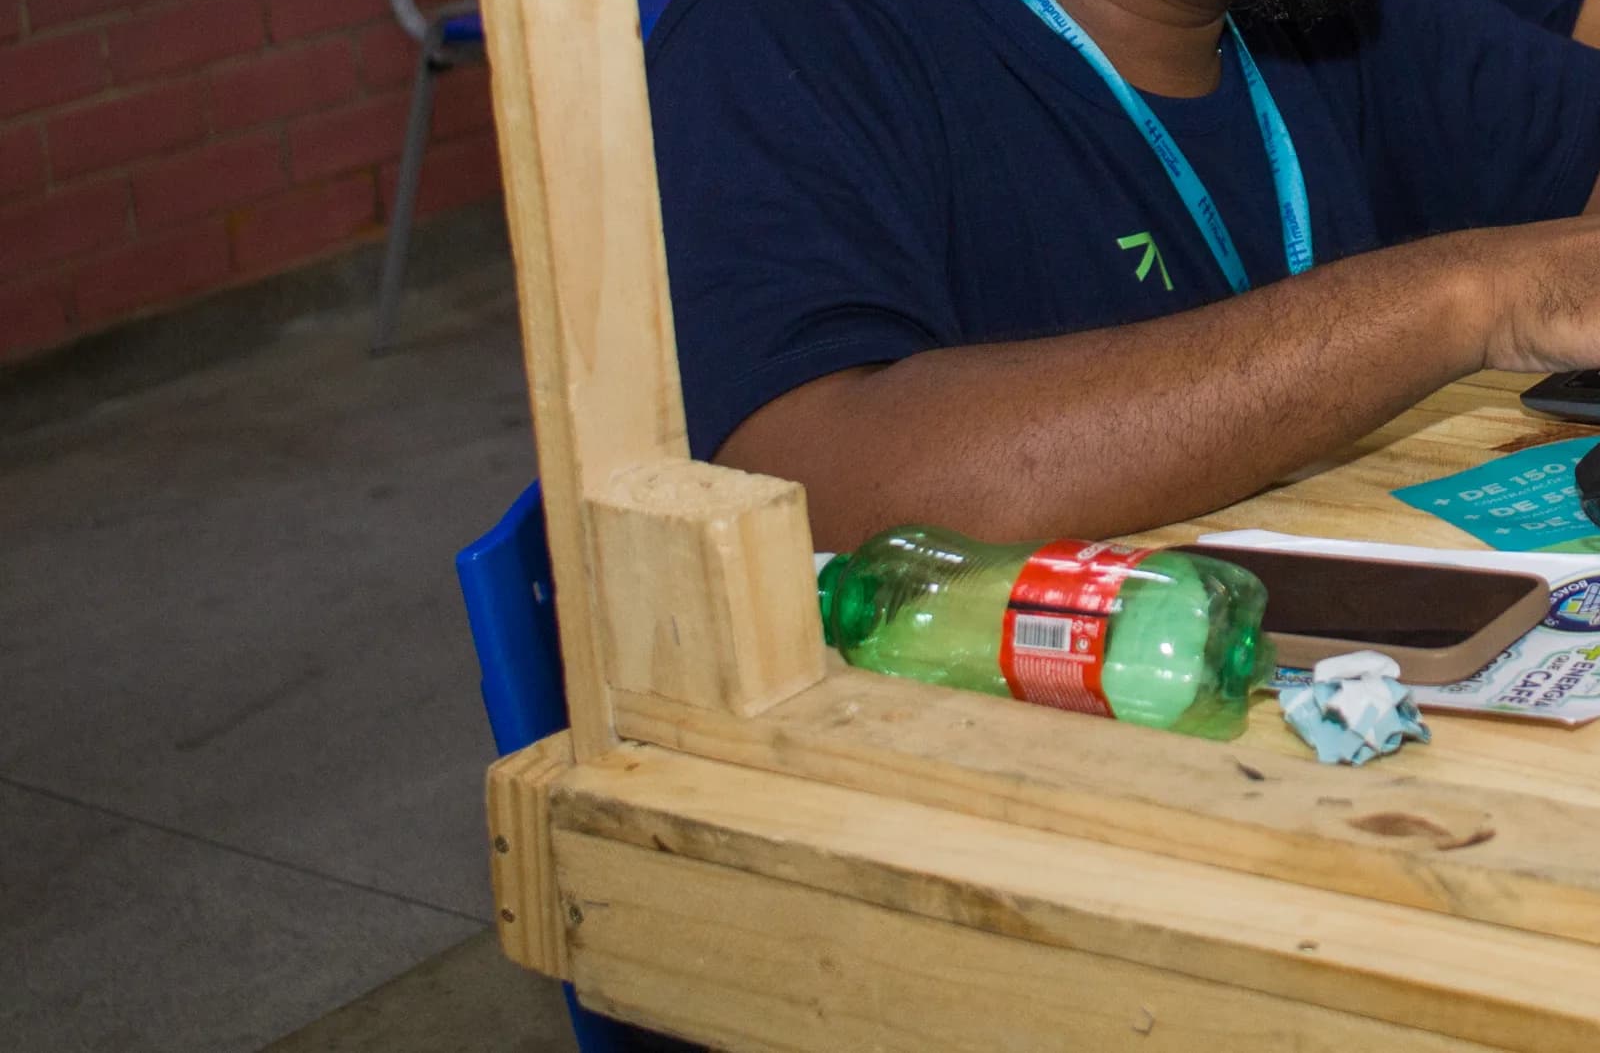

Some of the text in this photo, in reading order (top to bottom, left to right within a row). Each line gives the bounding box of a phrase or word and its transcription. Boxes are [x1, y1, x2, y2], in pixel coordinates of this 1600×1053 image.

[1458, 483, 1507, 501] DE
[1509, 463, 1567, 485] 150
[1488, 499, 1539, 517] DE
[1520, 516, 1571, 530] DE
[1547, 654, 1570, 671] QUE
[1534, 661, 1595, 707] ENERGIA
